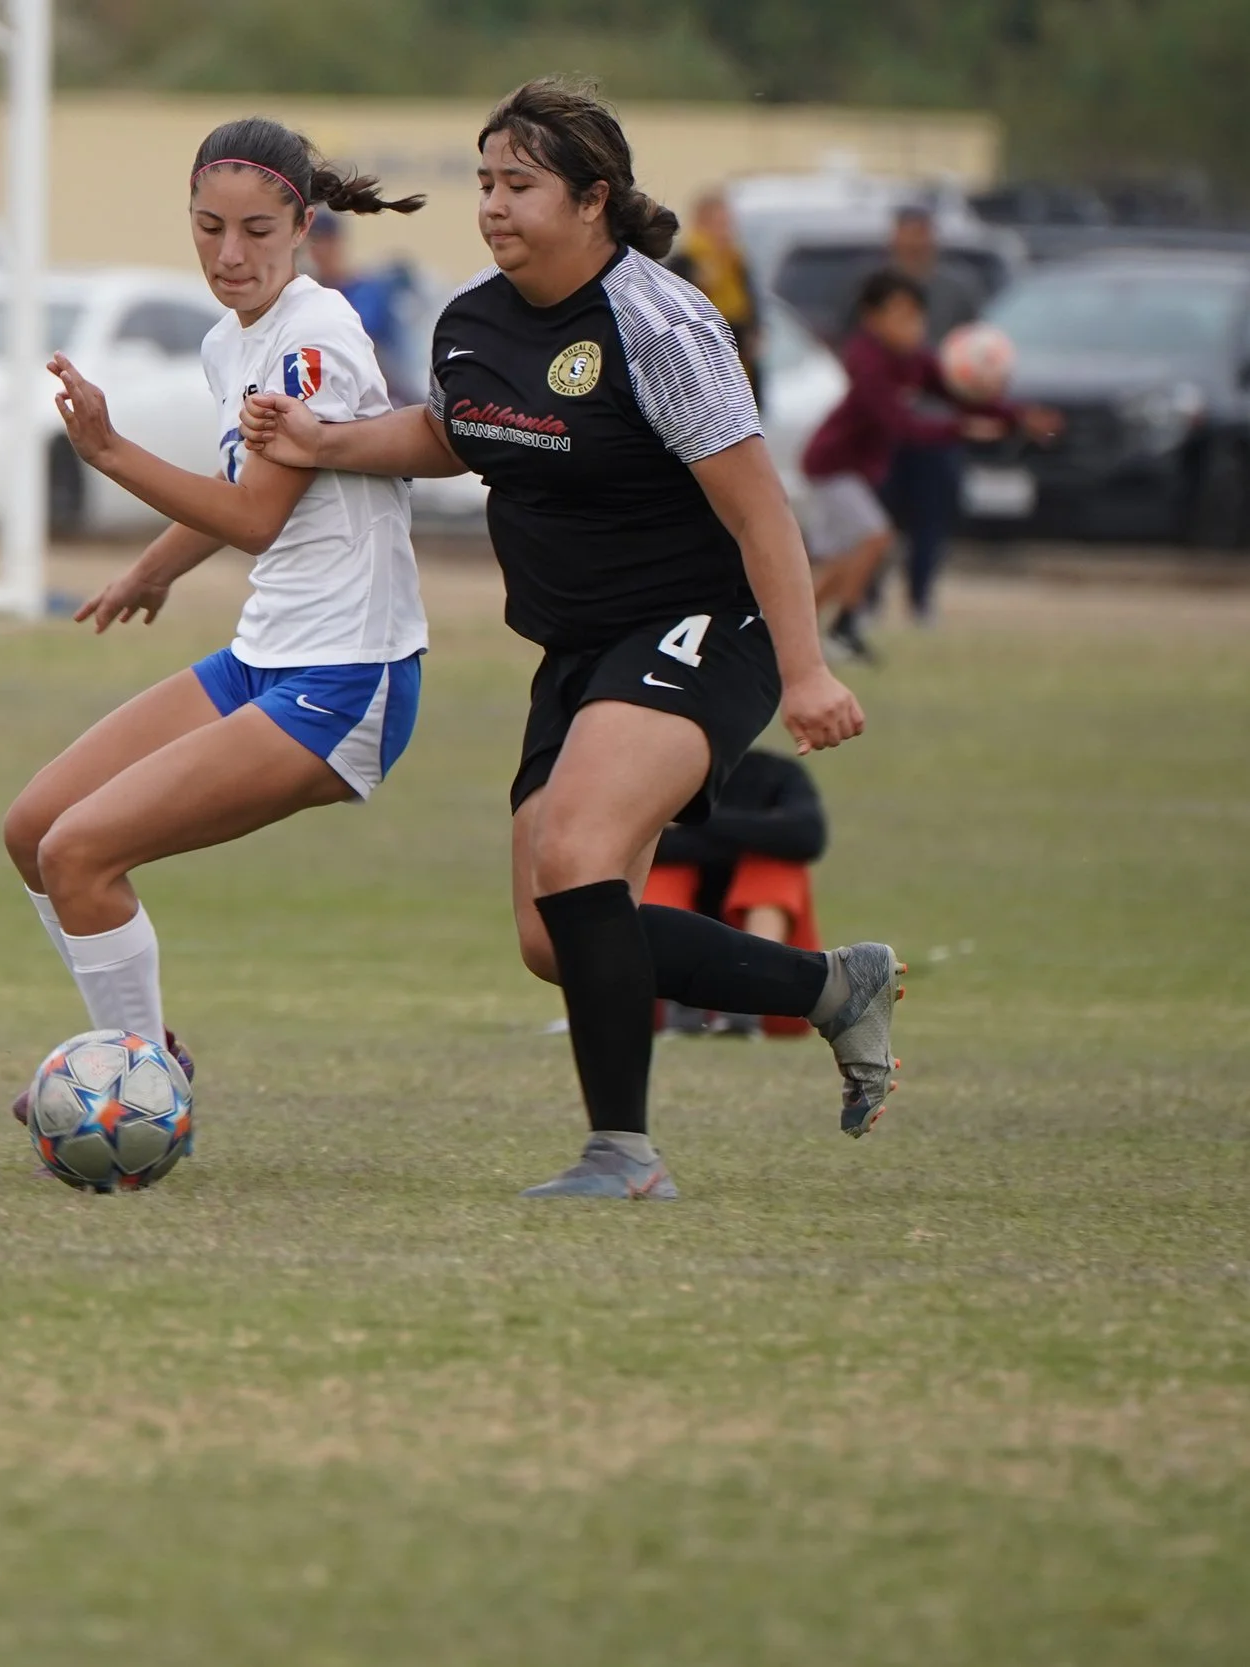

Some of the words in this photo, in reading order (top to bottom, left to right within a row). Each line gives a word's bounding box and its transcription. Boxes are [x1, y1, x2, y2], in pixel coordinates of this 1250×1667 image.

[549, 370, 576, 395] FOOTBALL
[578, 376, 597, 394] CLUB
[451, 399, 569, 435] California
[451, 419, 571, 451] TRANSMISSION
[657, 614, 712, 668] 4
